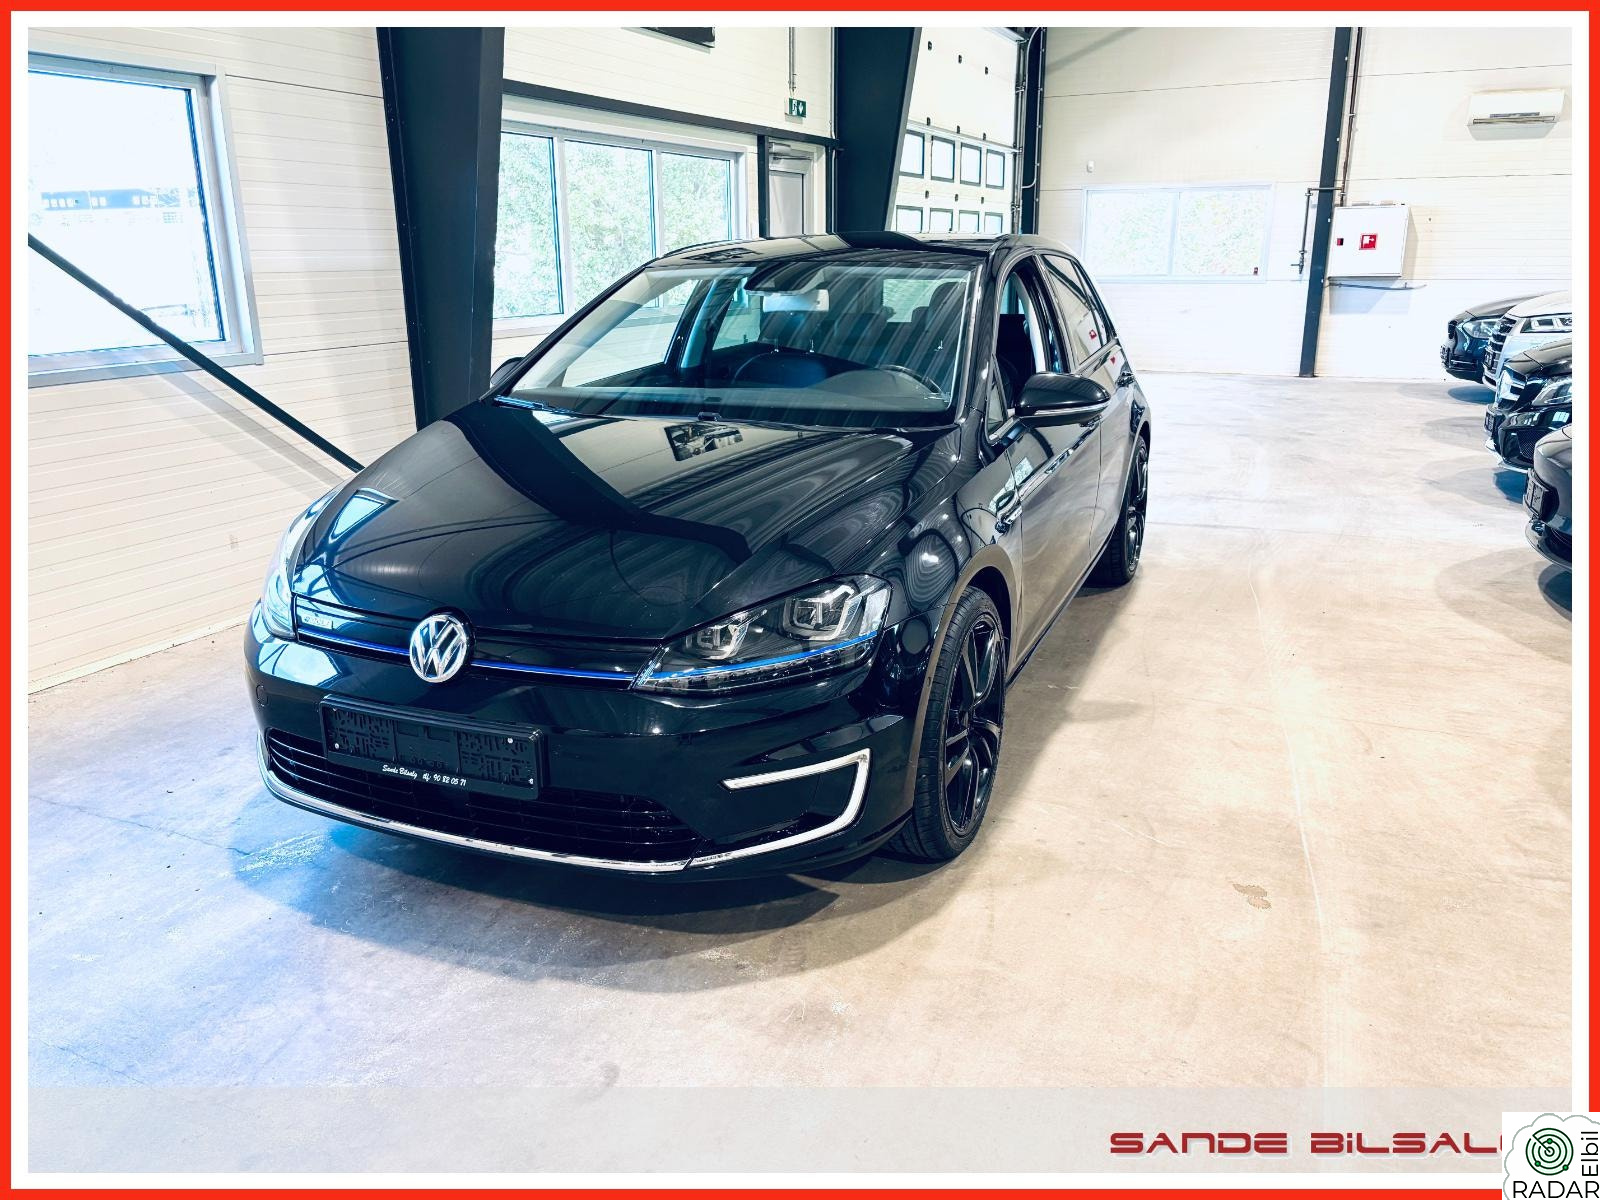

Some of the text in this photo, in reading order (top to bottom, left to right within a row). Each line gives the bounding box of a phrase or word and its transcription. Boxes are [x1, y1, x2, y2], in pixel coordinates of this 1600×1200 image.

[433, 774, 441, 782] 90
[442, 775, 450, 784] 82
[450, 777, 459, 785] 05
